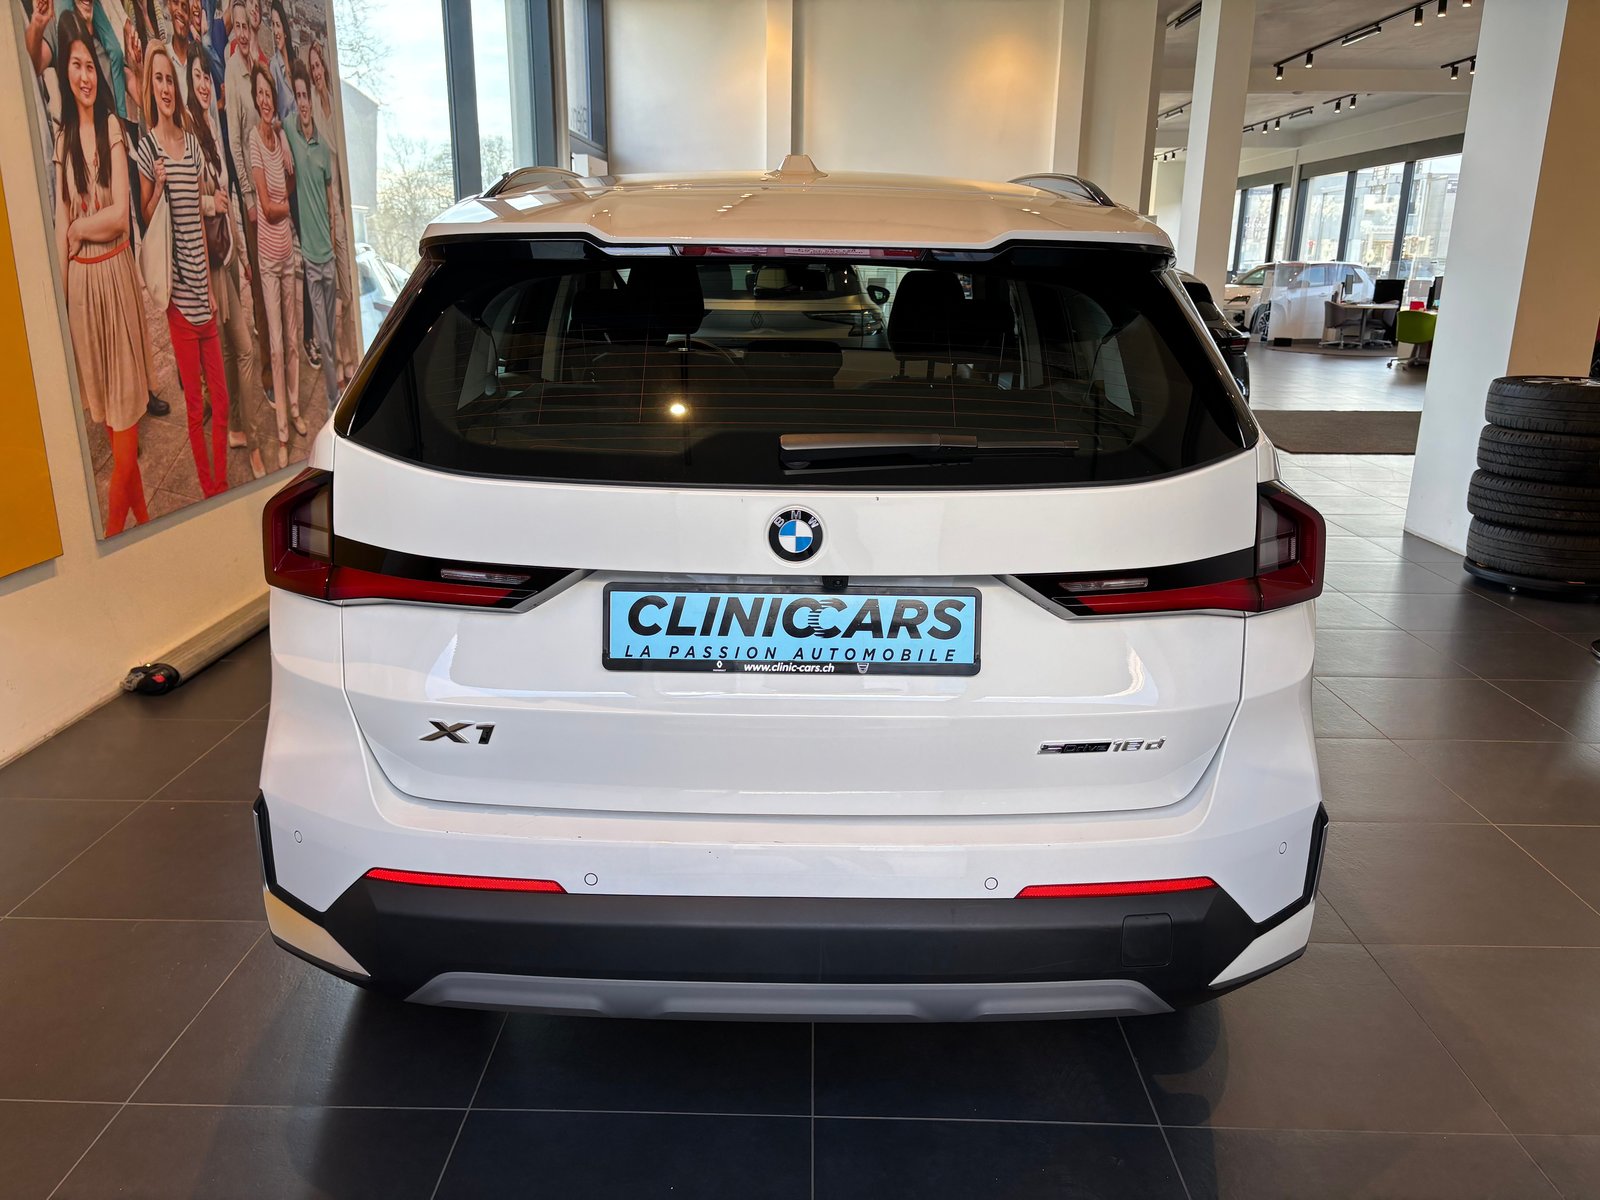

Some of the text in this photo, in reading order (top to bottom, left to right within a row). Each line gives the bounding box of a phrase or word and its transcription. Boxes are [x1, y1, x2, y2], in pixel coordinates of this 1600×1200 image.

[773, 510, 820, 529] BMW
[625, 645, 956, 662] LA PASSION AUTOMOBILE
[744, 662, 835, 673] www.clinic-cars.ch
[418, 718, 496, 745] X1
